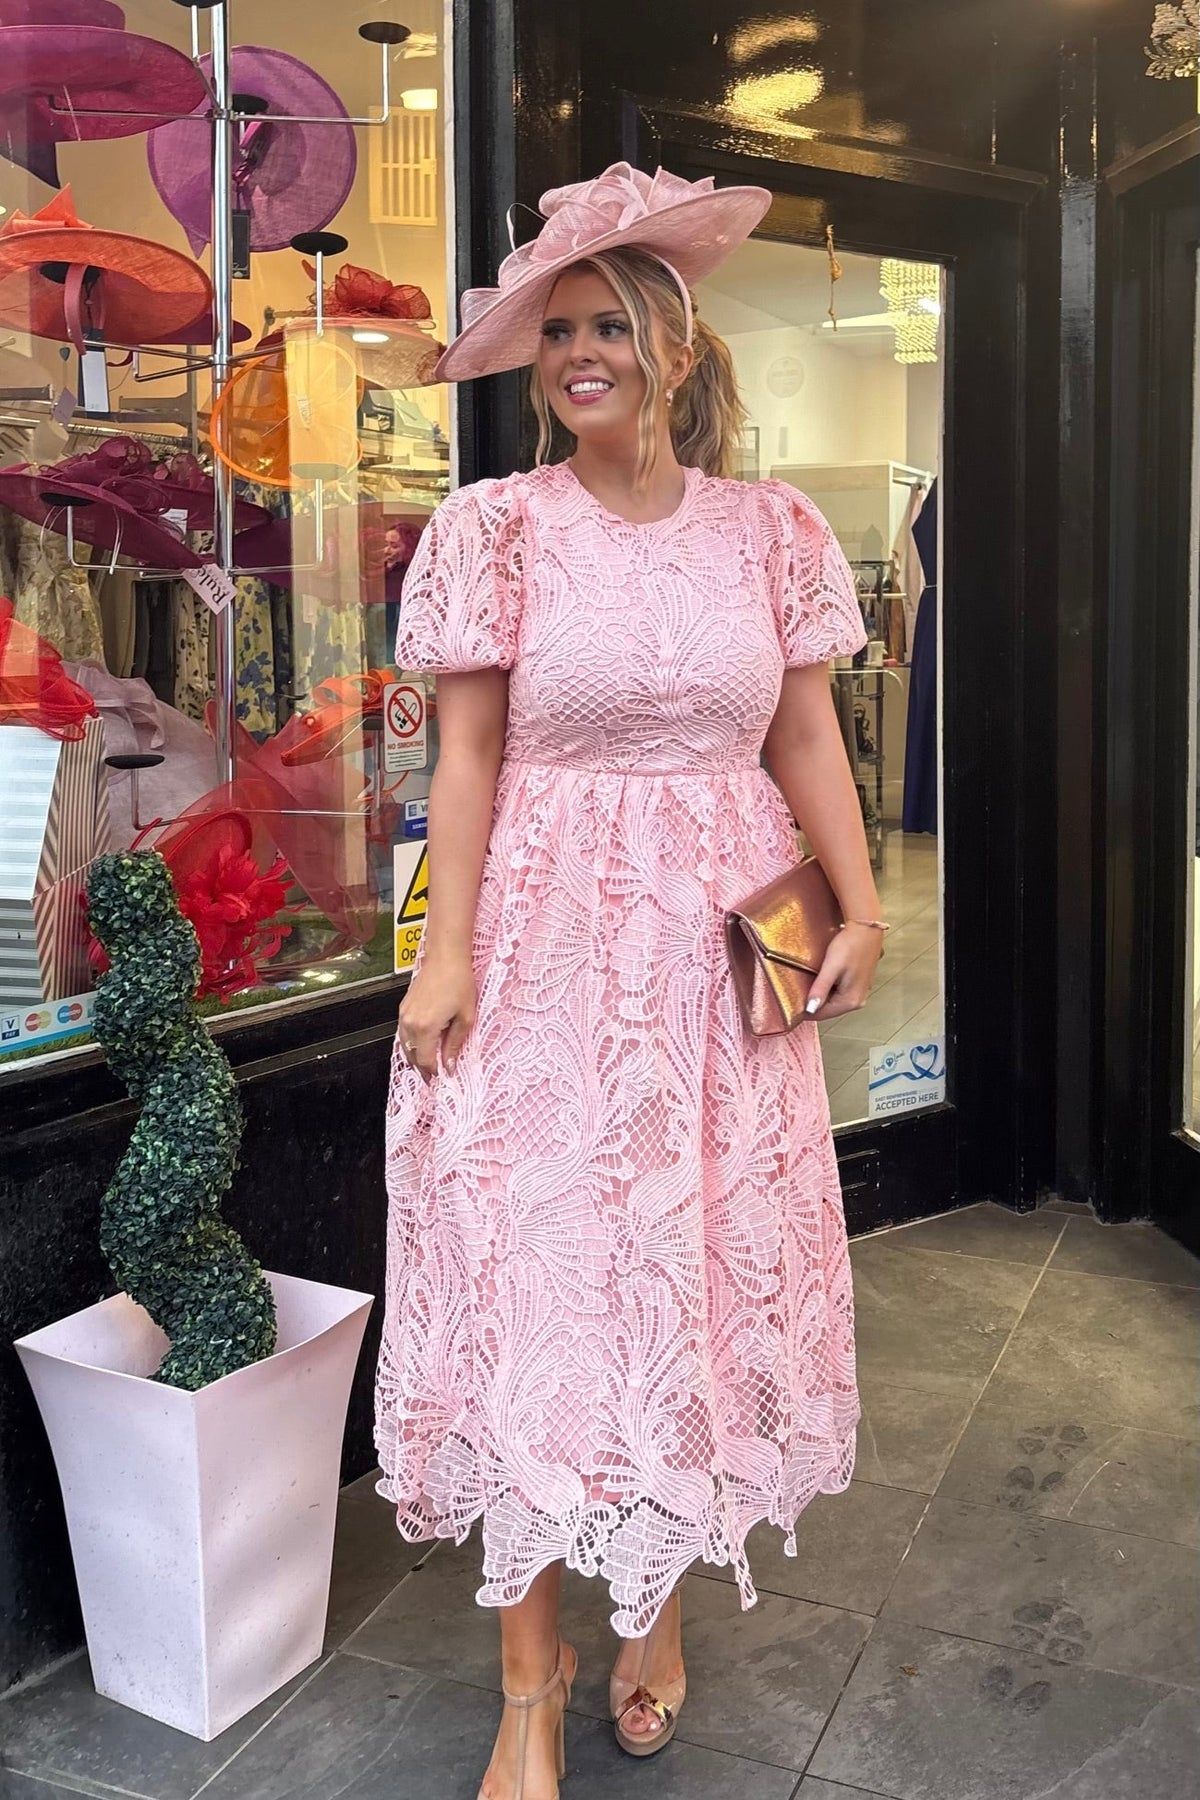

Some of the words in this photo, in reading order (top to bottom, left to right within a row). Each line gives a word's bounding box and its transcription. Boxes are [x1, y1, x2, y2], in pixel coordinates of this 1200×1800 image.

[397, 740, 424, 749] SMOKING
[406, 928, 422, 943] CC
[401, 948, 417, 962] Op
[875, 1096, 917, 1112] ACCEPTED
[918, 1091, 939, 1103] HERE
